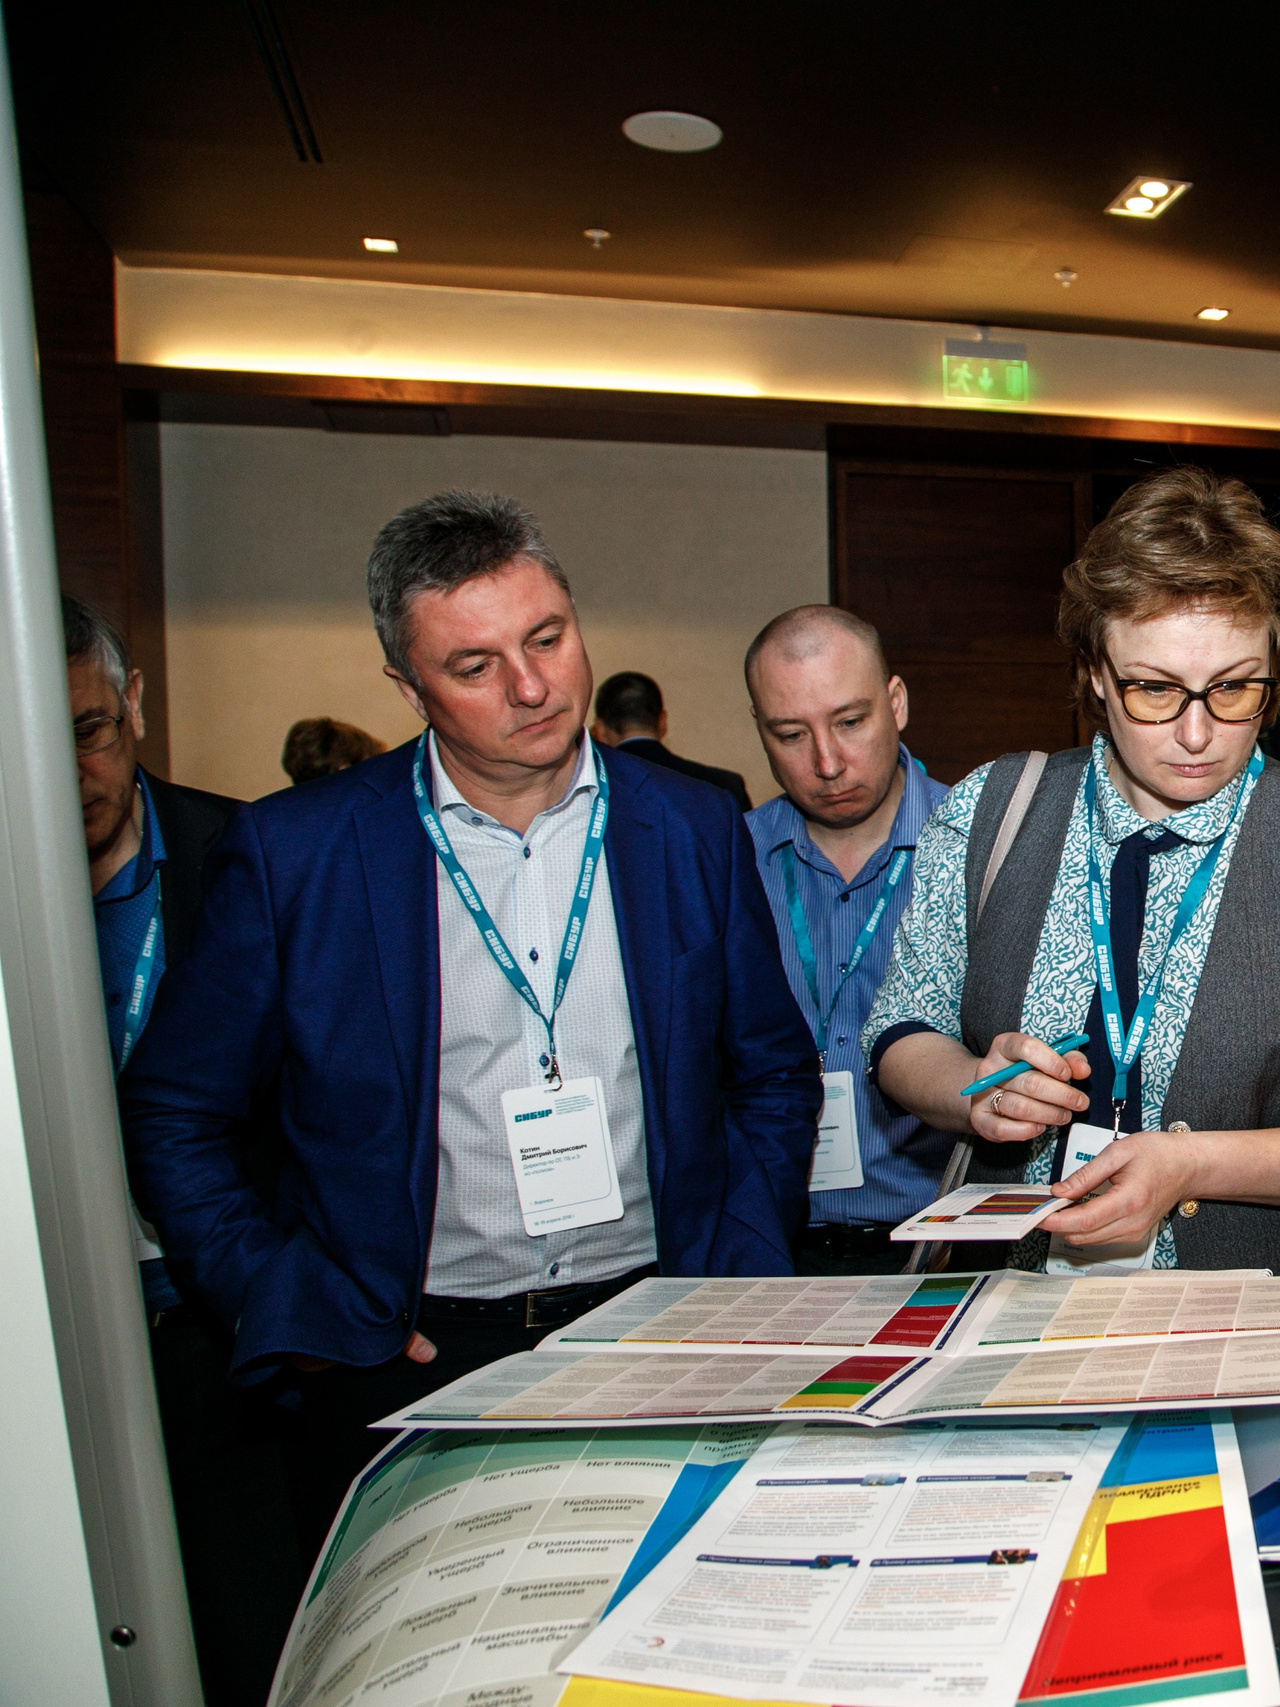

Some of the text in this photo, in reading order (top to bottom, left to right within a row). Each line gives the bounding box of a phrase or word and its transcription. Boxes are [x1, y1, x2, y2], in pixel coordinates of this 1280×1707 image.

[591, 797, 606, 839] СИБУР
[423, 813, 450, 855] СИБУР
[578, 856, 595, 899] СИБУР
[888, 850, 907, 886] СИБУР
[452, 871, 482, 912] СИБУР
[1091, 880, 1105, 925] СИБУР
[865, 898, 885, 933] СИБУР
[142, 917, 157, 957] СИБУР
[564, 916, 582, 961] СИБУР
[484, 929, 514, 971] СИБУР
[1097, 944, 1113, 992] СИБУР
[129, 974, 145, 1015] СИБУР
[1122, 1015, 1146, 1065] СИБУР
[514, 1109, 553, 1123] СИБУР
[520, 1146, 540, 1154] Котин
[521, 1144, 588, 1161] Дмитрий Борисович
[483, 1464, 560, 1483] Нет ущерба
[563, 1498, 645, 1507] Небольшое
[572, 1504, 632, 1513] влияние
[454, 1504, 532, 1530] Небольшой
[468, 1515, 513, 1533] ущерб
[527, 1537, 634, 1550] Ограниченное
[546, 1545, 609, 1555] влияние
[427, 1549, 505, 1577] Умеренный
[439, 1561, 485, 1581] ущерб
[501, 1578, 610, 1596] Значительное
[520, 1588, 586, 1601] влияние
[398, 1596, 477, 1631] Локальный
[411, 1610, 457, 1633] ущерб
[470, 1621, 590, 1646] Национальные
[485, 1632, 568, 1651] масштабы
[1184, 1653, 1223, 1667] риск
